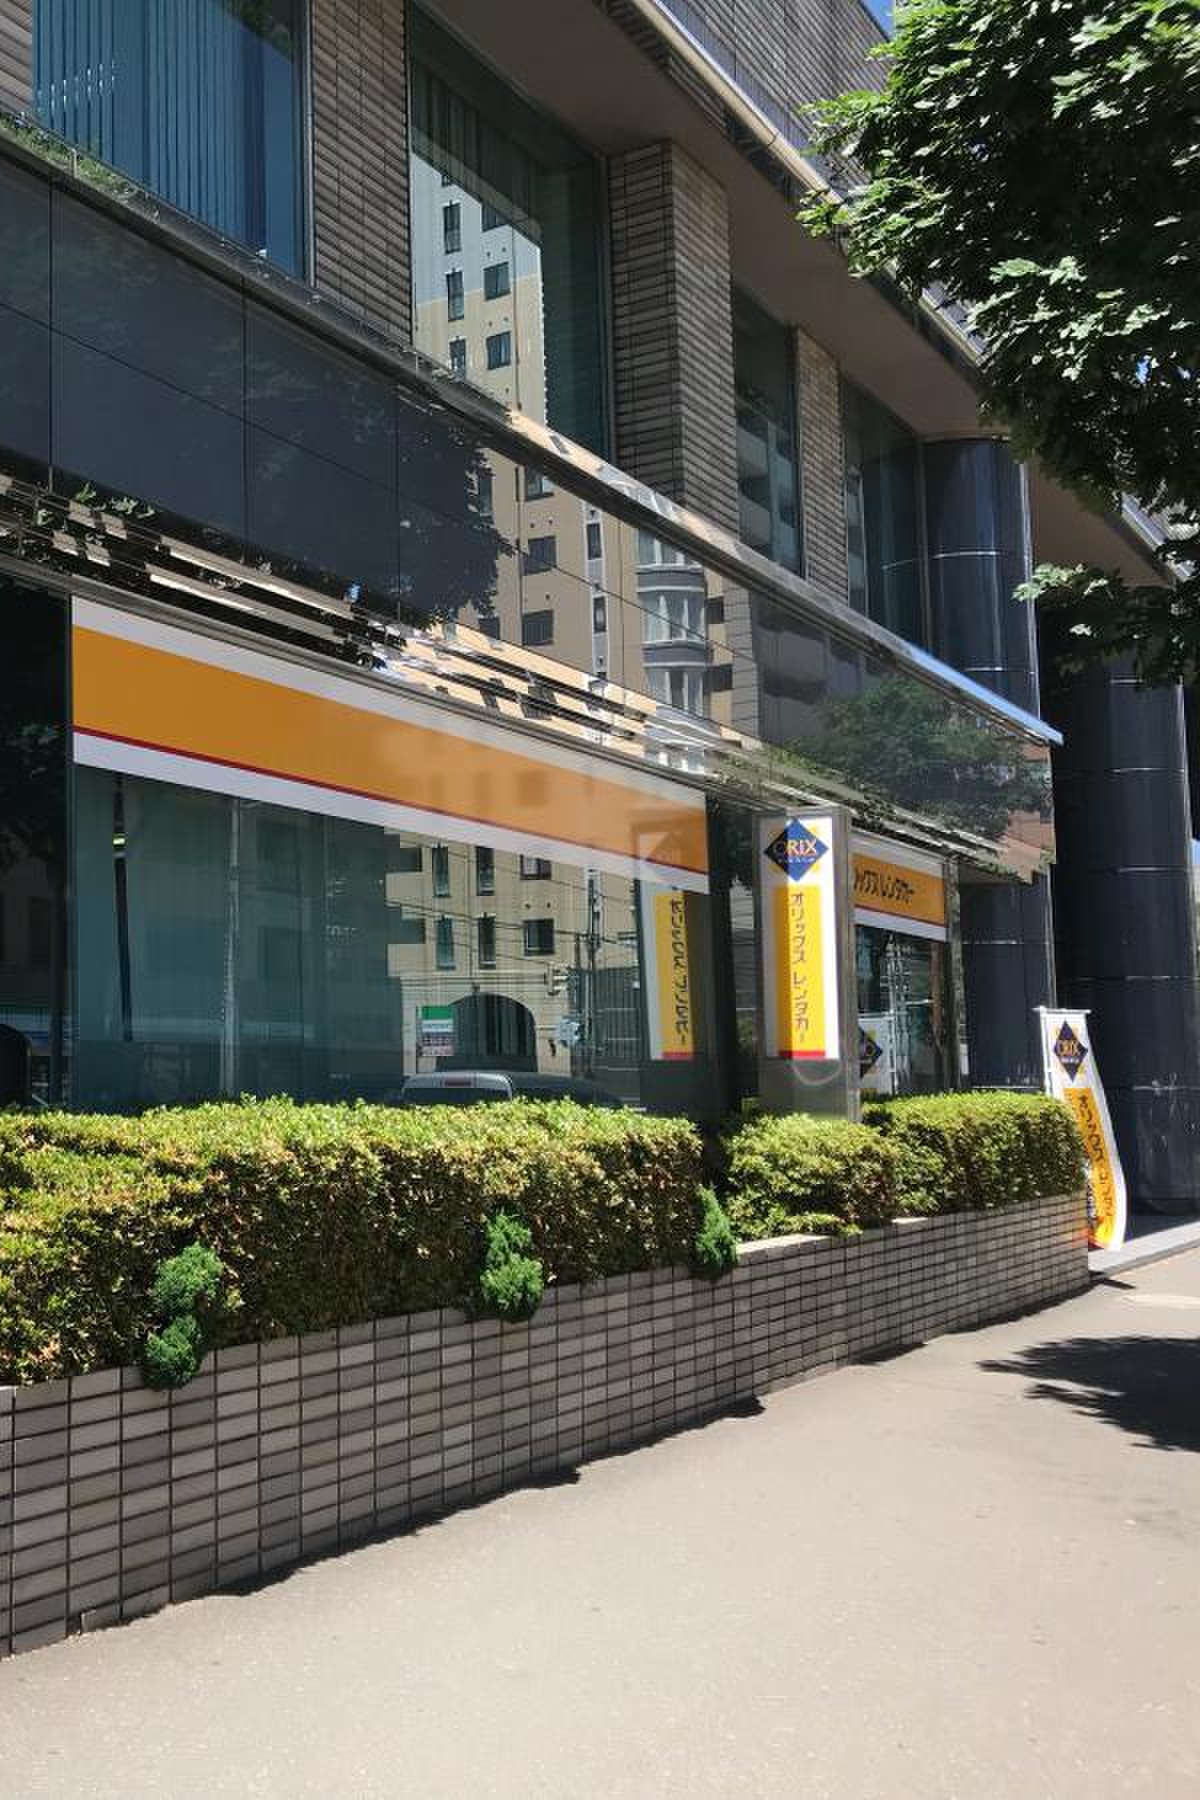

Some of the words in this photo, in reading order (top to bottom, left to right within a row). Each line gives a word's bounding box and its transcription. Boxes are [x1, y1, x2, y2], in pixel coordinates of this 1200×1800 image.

[792, 892, 807, 966] オリックス
[793, 971, 810, 1042] レンタカー
